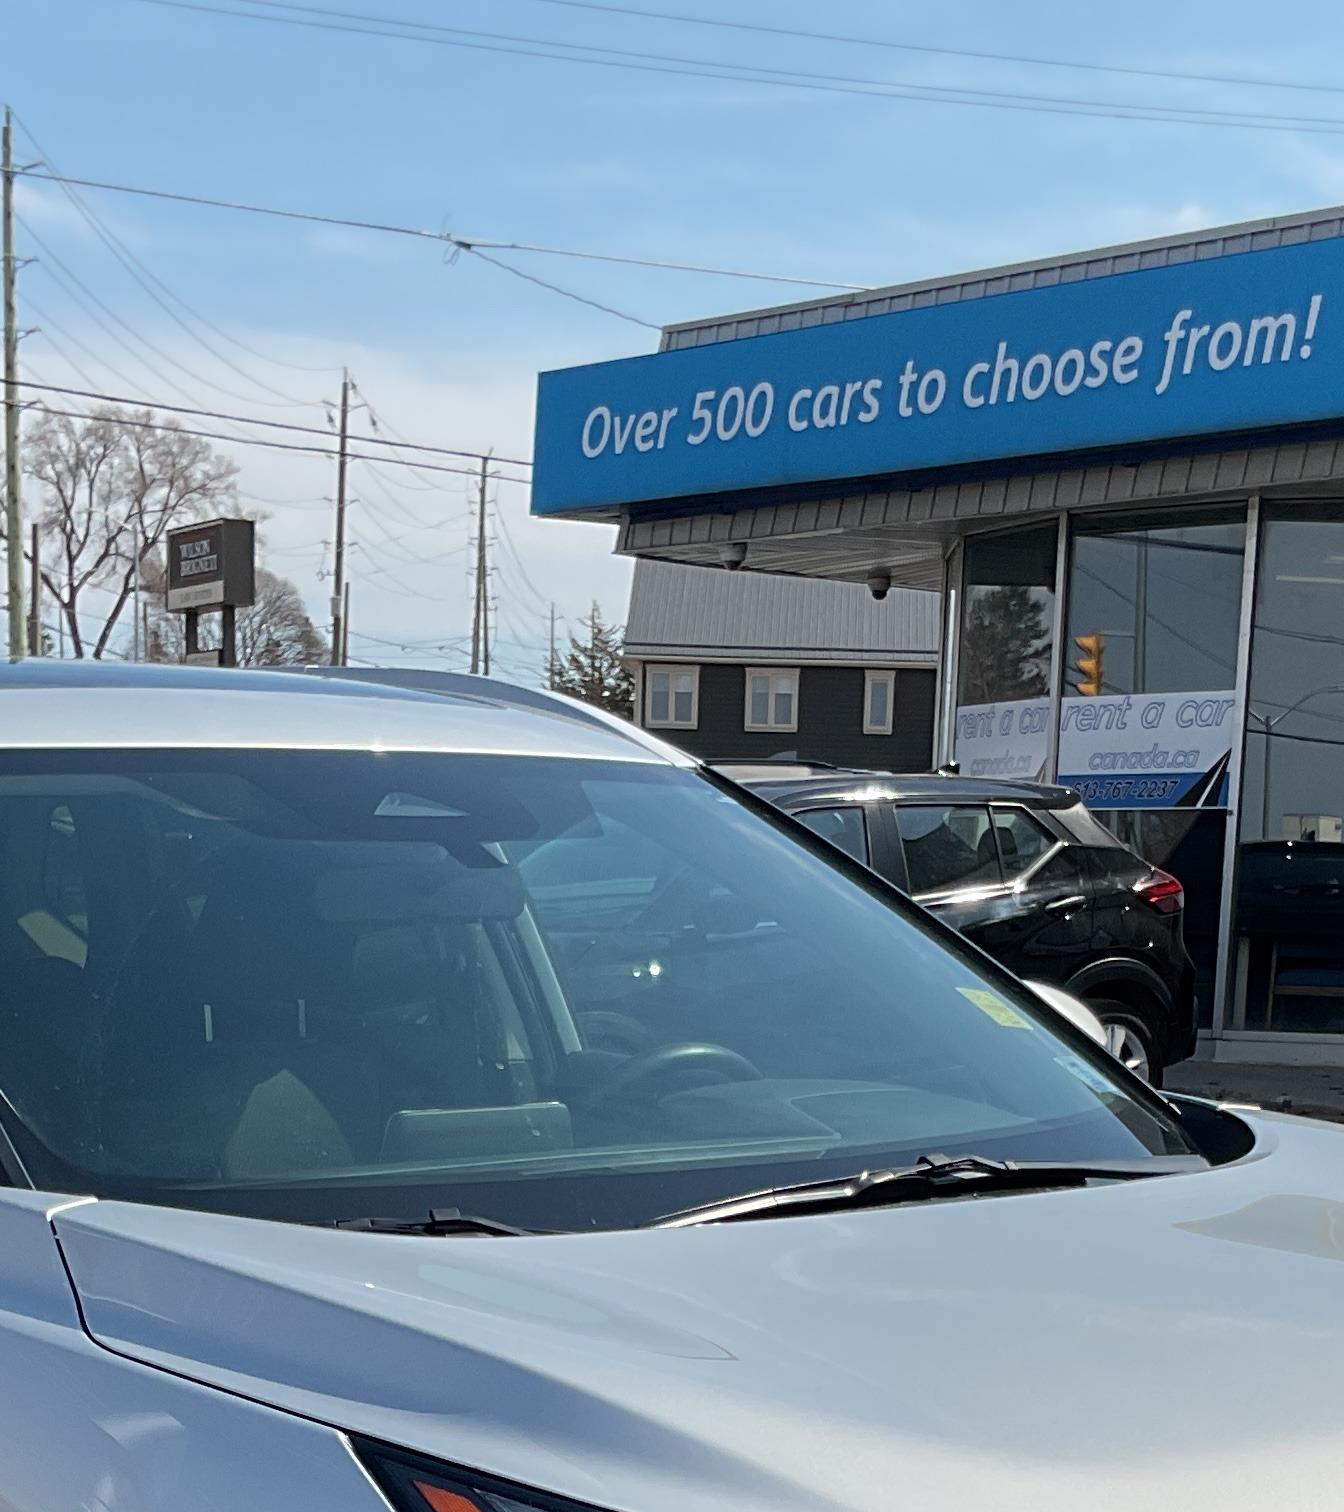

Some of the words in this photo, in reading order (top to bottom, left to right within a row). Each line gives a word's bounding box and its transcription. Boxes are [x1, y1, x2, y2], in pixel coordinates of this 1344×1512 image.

[582, 405, 678, 459] Over
[687, 382, 774, 446] 500
[788, 377, 883, 432] cars
[898, 359, 946, 417] to
[963, 336, 1144, 408] choose
[1156, 295, 1322, 396] from!
[956, 703, 995, 740] rent
[1061, 696, 1133, 732] rent
[1142, 700, 1166, 730] a
[1175, 699, 1235, 729] car
[1088, 743, 1201, 771] canada.ca
